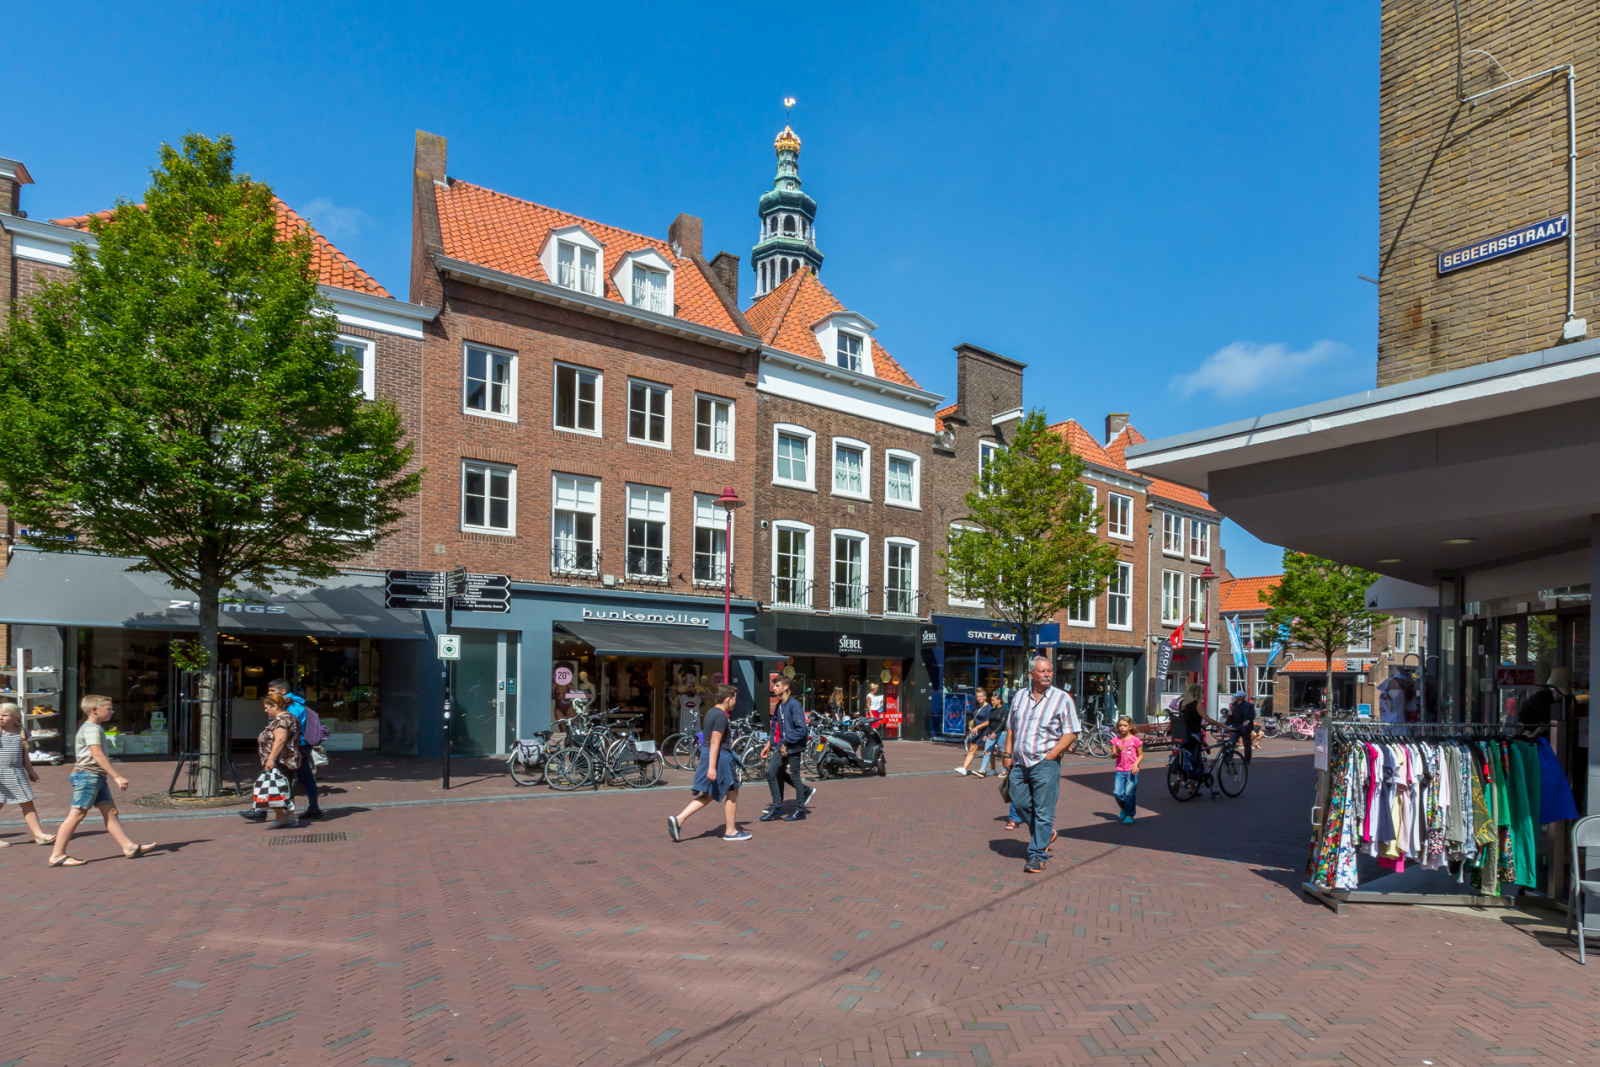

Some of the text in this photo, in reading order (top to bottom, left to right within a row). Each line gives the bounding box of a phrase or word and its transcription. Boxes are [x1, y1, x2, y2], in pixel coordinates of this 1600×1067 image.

[1443, 220, 1564, 268] SEGEERSSTRAAT
[582, 607, 710, 625] hunkemöller
[967, 631, 993, 639] STATE
[839, 639, 862, 649] SIEBEL
